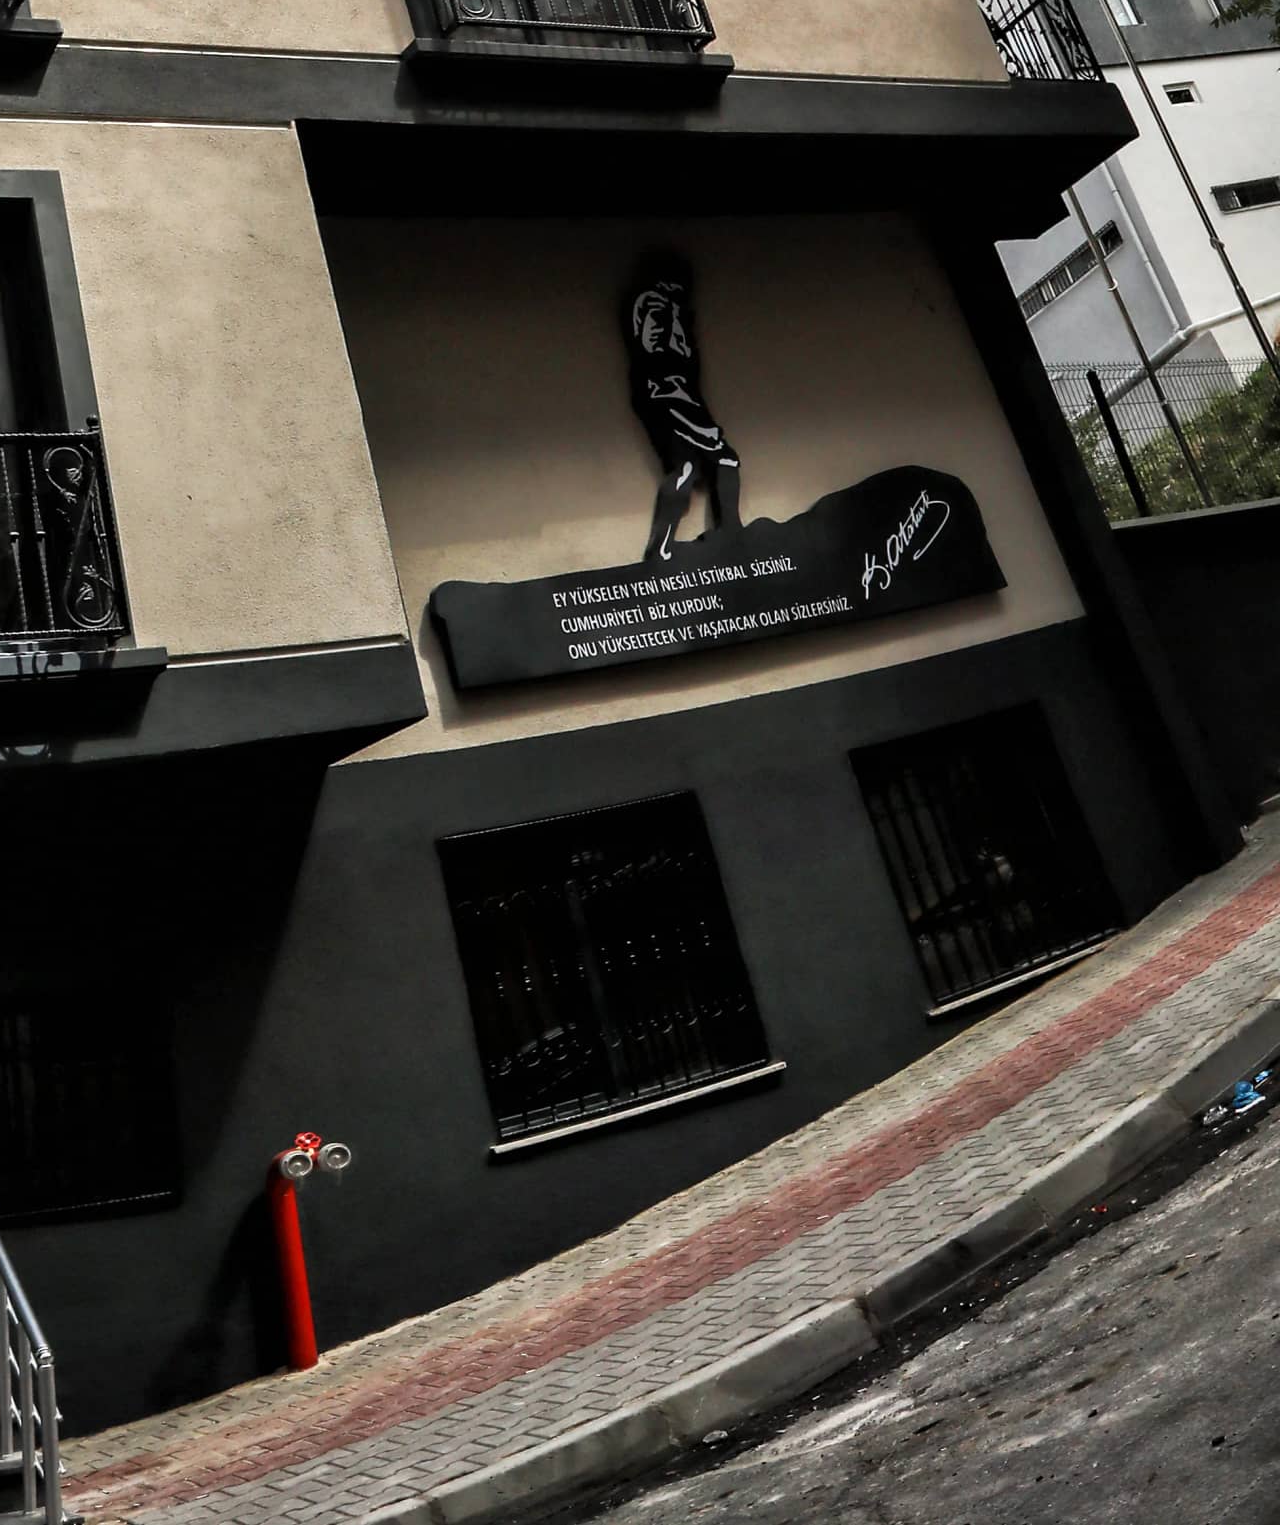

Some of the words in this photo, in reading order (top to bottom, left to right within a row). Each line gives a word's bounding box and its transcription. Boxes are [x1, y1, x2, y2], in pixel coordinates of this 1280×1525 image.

[552, 591, 567, 608] EY
[569, 584, 630, 606] YÜKSELEN
[630, 576, 659, 599] YENİ
[660, 571, 698, 592] NESİL!
[697, 565, 748, 586] İSTİKBAL
[750, 555, 797, 577] SİZSİNİZ.
[561, 604, 644, 634] CUMHURİYETİ
[648, 602, 669, 621] BİZ
[669, 594, 724, 617] KURDUK;
[568, 642, 598, 660] ONU
[598, 628, 678, 655] YÜKSELTECEK
[677, 627, 695, 642] VE
[695, 613, 759, 639] YAŞATACAK
[759, 608, 790, 627] OLAN
[791, 595, 853, 621] SİZLERSİNİZ.
